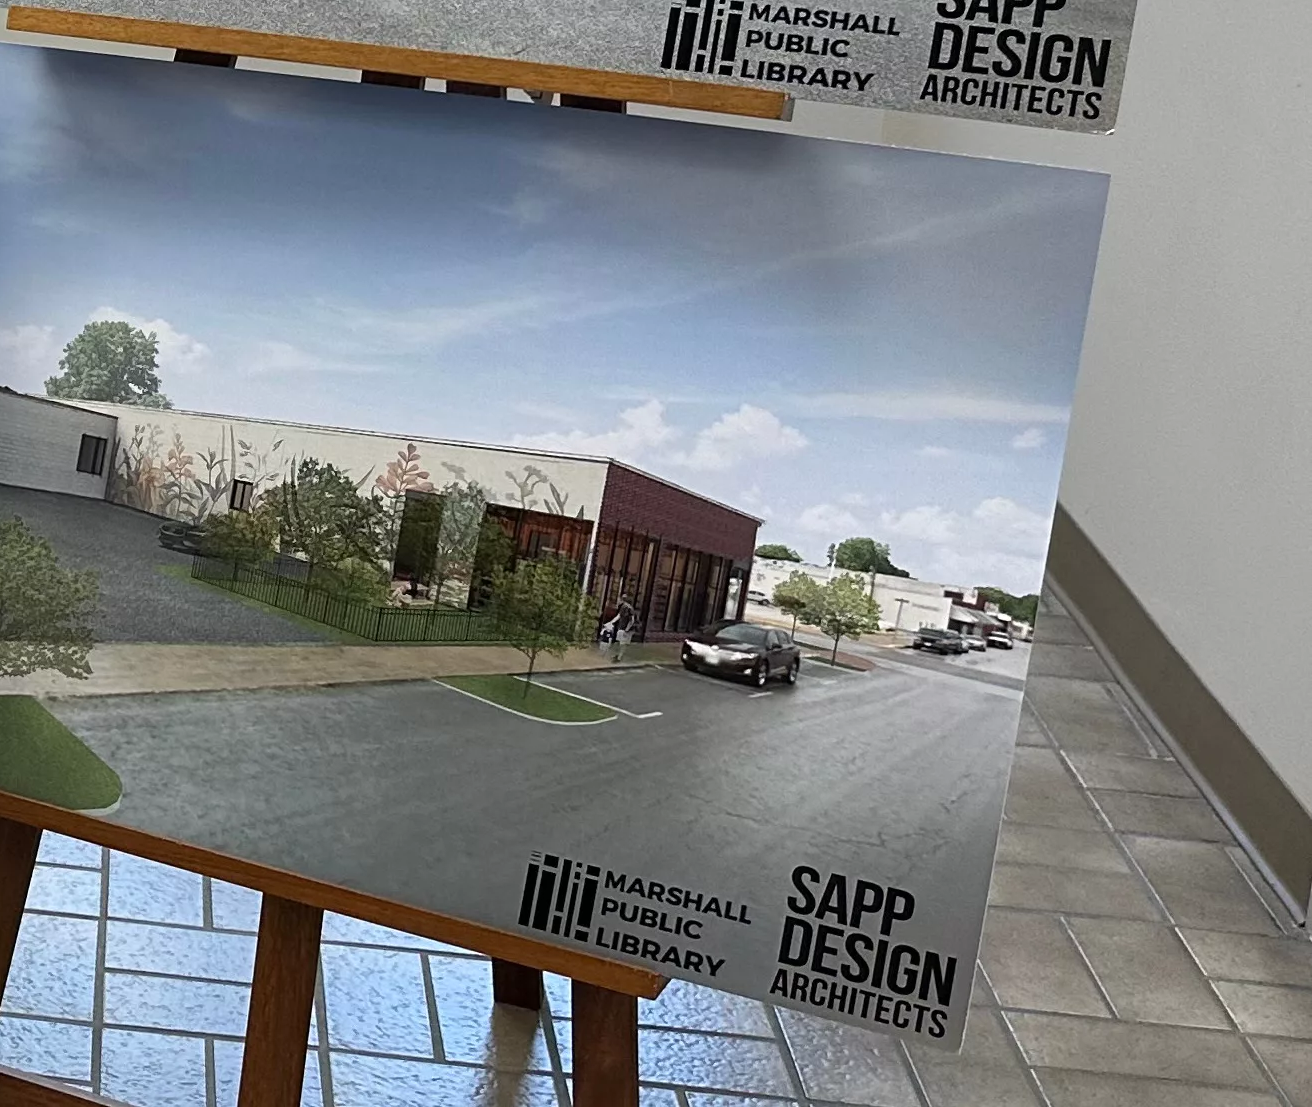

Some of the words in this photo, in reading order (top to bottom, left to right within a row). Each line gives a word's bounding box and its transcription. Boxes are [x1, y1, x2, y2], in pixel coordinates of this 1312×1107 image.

[748, 2, 901, 36] MARSHALL
[745, 30, 851, 59] PUBLIC
[927, 21, 1112, 88] DESIGN
[739, 58, 875, 92] LIBRARY
[920, 74, 1102, 120] ARCHITECTS
[600, 897, 703, 940] PUBLIC
[603, 870, 752, 925] MARSHALL
[786, 865, 916, 936] SAPP
[595, 927, 726, 977] LIBRARY
[777, 915, 958, 1007] DESIGN
[769, 968, 948, 1039] ARCHITECTS
